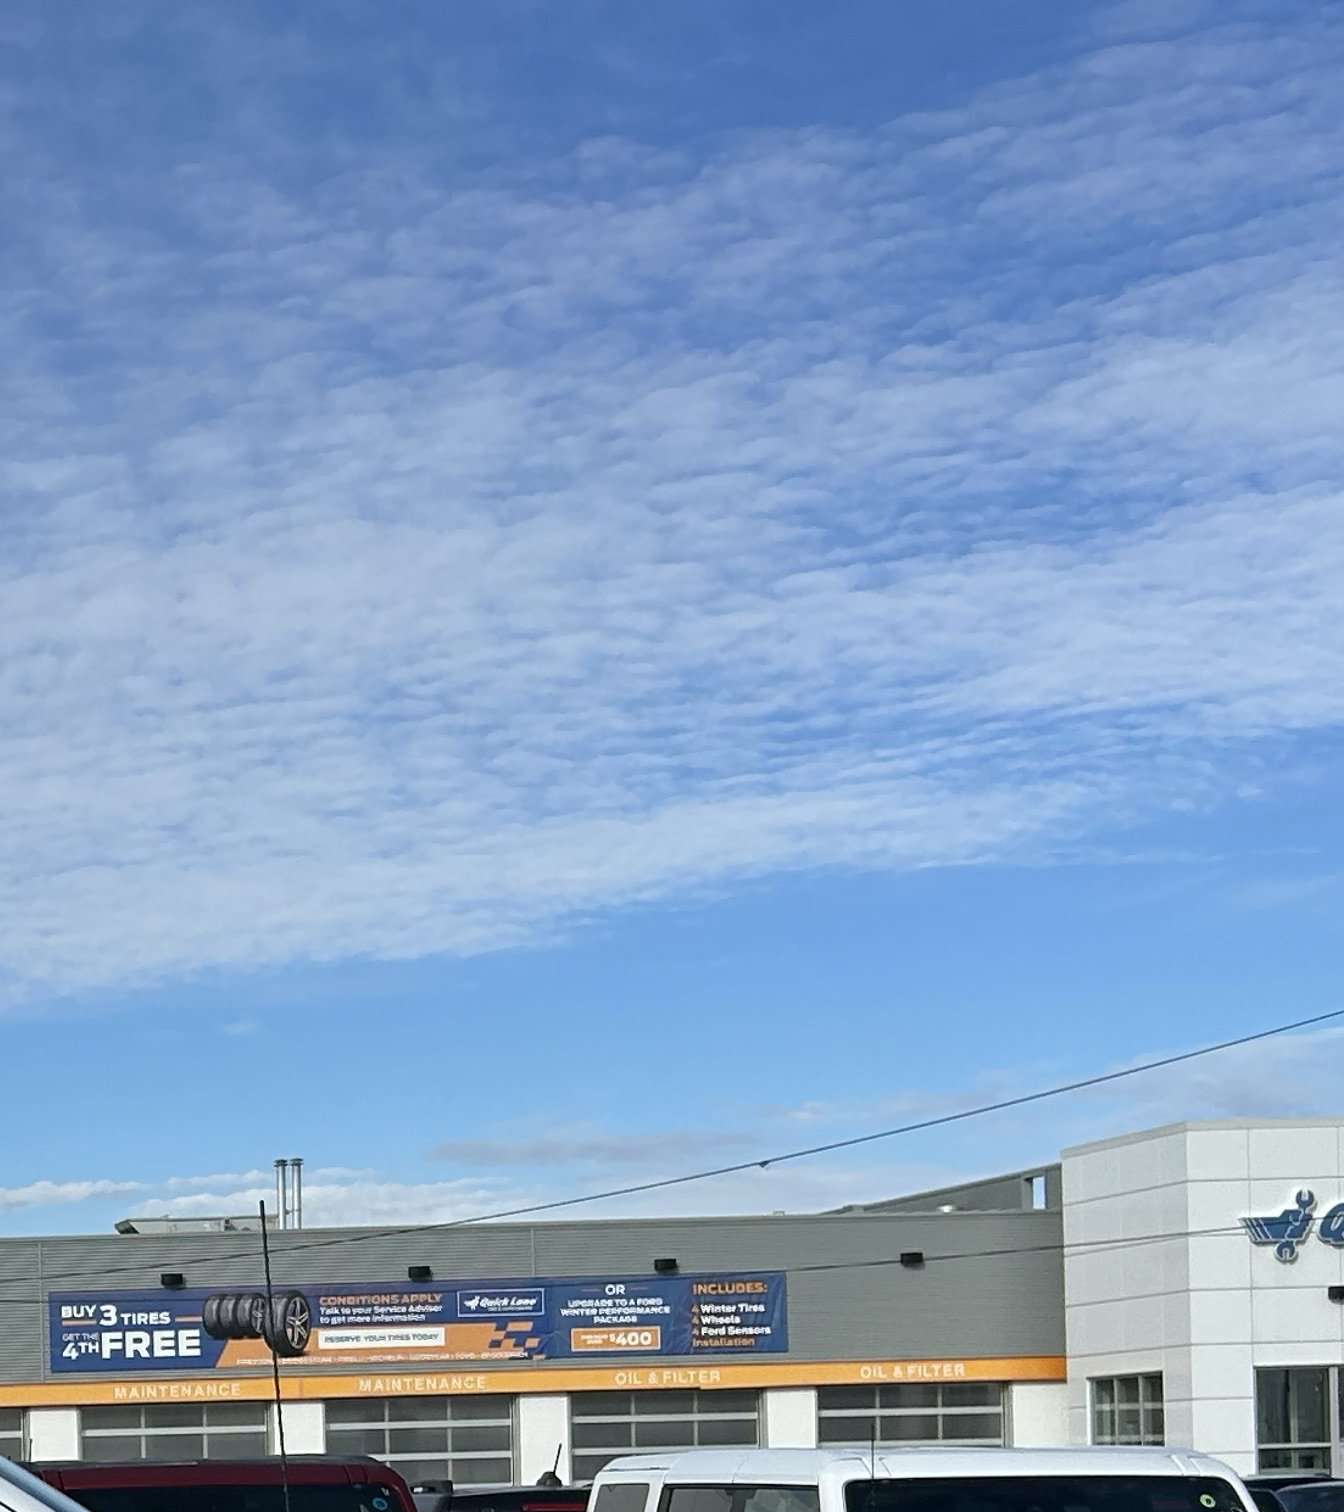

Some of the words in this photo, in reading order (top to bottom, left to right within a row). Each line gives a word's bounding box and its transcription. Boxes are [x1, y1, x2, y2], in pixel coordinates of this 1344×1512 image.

[604, 1284, 626, 1296] OR
[692, 1282, 769, 1295] INCLUDES:
[319, 1294, 399, 1306] CONDITIONS
[400, 1293, 443, 1304] APPLY
[479, 1297, 510, 1308] Quick
[510, 1296, 537, 1306] Lane
[567, 1299, 612, 1308] UPGRADE
[613, 1299, 628, 1307] TO
[628, 1298, 636, 1306] A
[636, 1297, 664, 1306] FORD
[319, 1306, 340, 1315] Talk
[340, 1306, 351, 1315] to
[352, 1307, 372, 1316] your
[374, 1305, 407, 1314] Service
[560, 1308, 598, 1317] WINTER
[598, 1306, 671, 1315] PERFORMANCE
[700, 1304, 737, 1314] Winter
[737, 1303, 766, 1313] Tires
[61, 1304, 97, 1319] BUY
[99, 1304, 118, 1326] 3
[120, 1311, 172, 1326] TIRES
[319, 1315, 330, 1324] to
[330, 1315, 346, 1325] get
[347, 1315, 371, 1323] more
[372, 1313, 426, 1322] information
[593, 1315, 638, 1324] PACKAGE
[700, 1315, 742, 1325] Wheels
[701, 1326, 726, 1336] Ford
[727, 1325, 772, 1336] Sensors
[62, 1333, 81, 1342] GET
[82, 1332, 99, 1341] THE
[324, 1335, 361, 1343] RESERVE
[412, 1333, 439, 1341] TODAY
[609, 1331, 652, 1346] $400
[693, 1337, 756, 1347] Installation
[62, 1342, 99, 1361] 4TH
[101, 1328, 202, 1360] FREE
[861, 1365, 888, 1378] OIL
[892, 1365, 904, 1378] &
[906, 1363, 966, 1378] FILTER
[615, 1372, 645, 1385] OIL
[648, 1371, 659, 1385] &
[662, 1370, 721, 1384] FILTER
[359, 1376, 487, 1392] MAINTENANCE
[114, 1383, 242, 1400] MAINTENANCE
